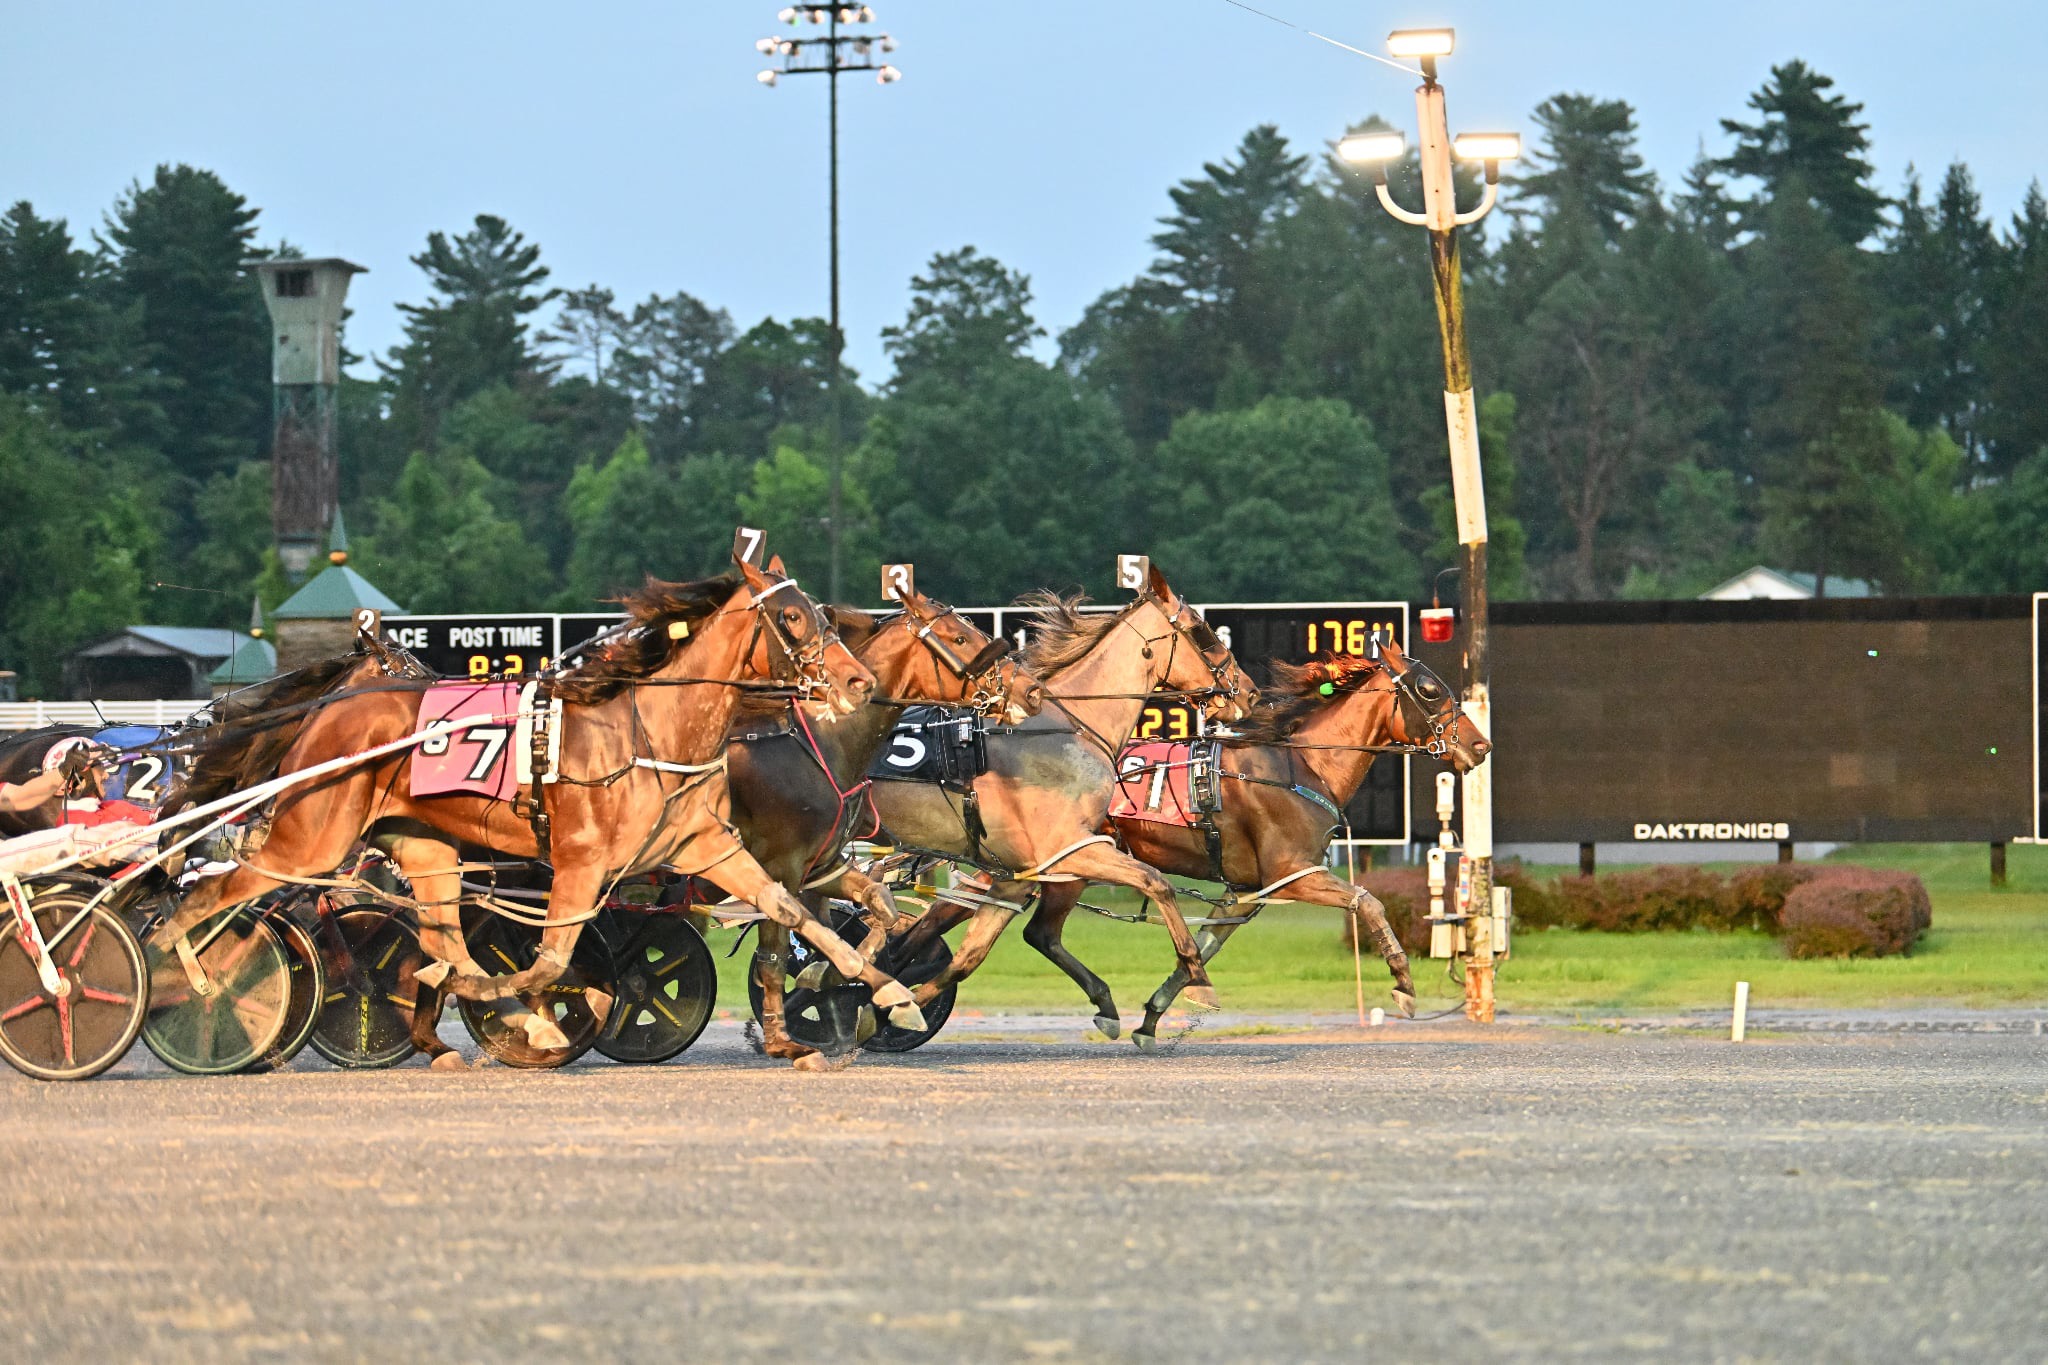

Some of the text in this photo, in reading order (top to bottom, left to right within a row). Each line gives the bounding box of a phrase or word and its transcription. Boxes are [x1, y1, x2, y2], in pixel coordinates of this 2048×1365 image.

[741, 528, 762, 563] 7
[888, 565, 909, 599] 3
[1122, 555, 1143, 588] 5
[358, 609, 375, 637] 2
[449, 626, 543, 648] POST TIME
[1370, 631, 1381, 659] 1
[467, 728, 508, 779] 7
[886, 722, 926, 767] 5
[126, 756, 163, 800] 2
[1634, 823, 1790, 840] DAKTRONICS
